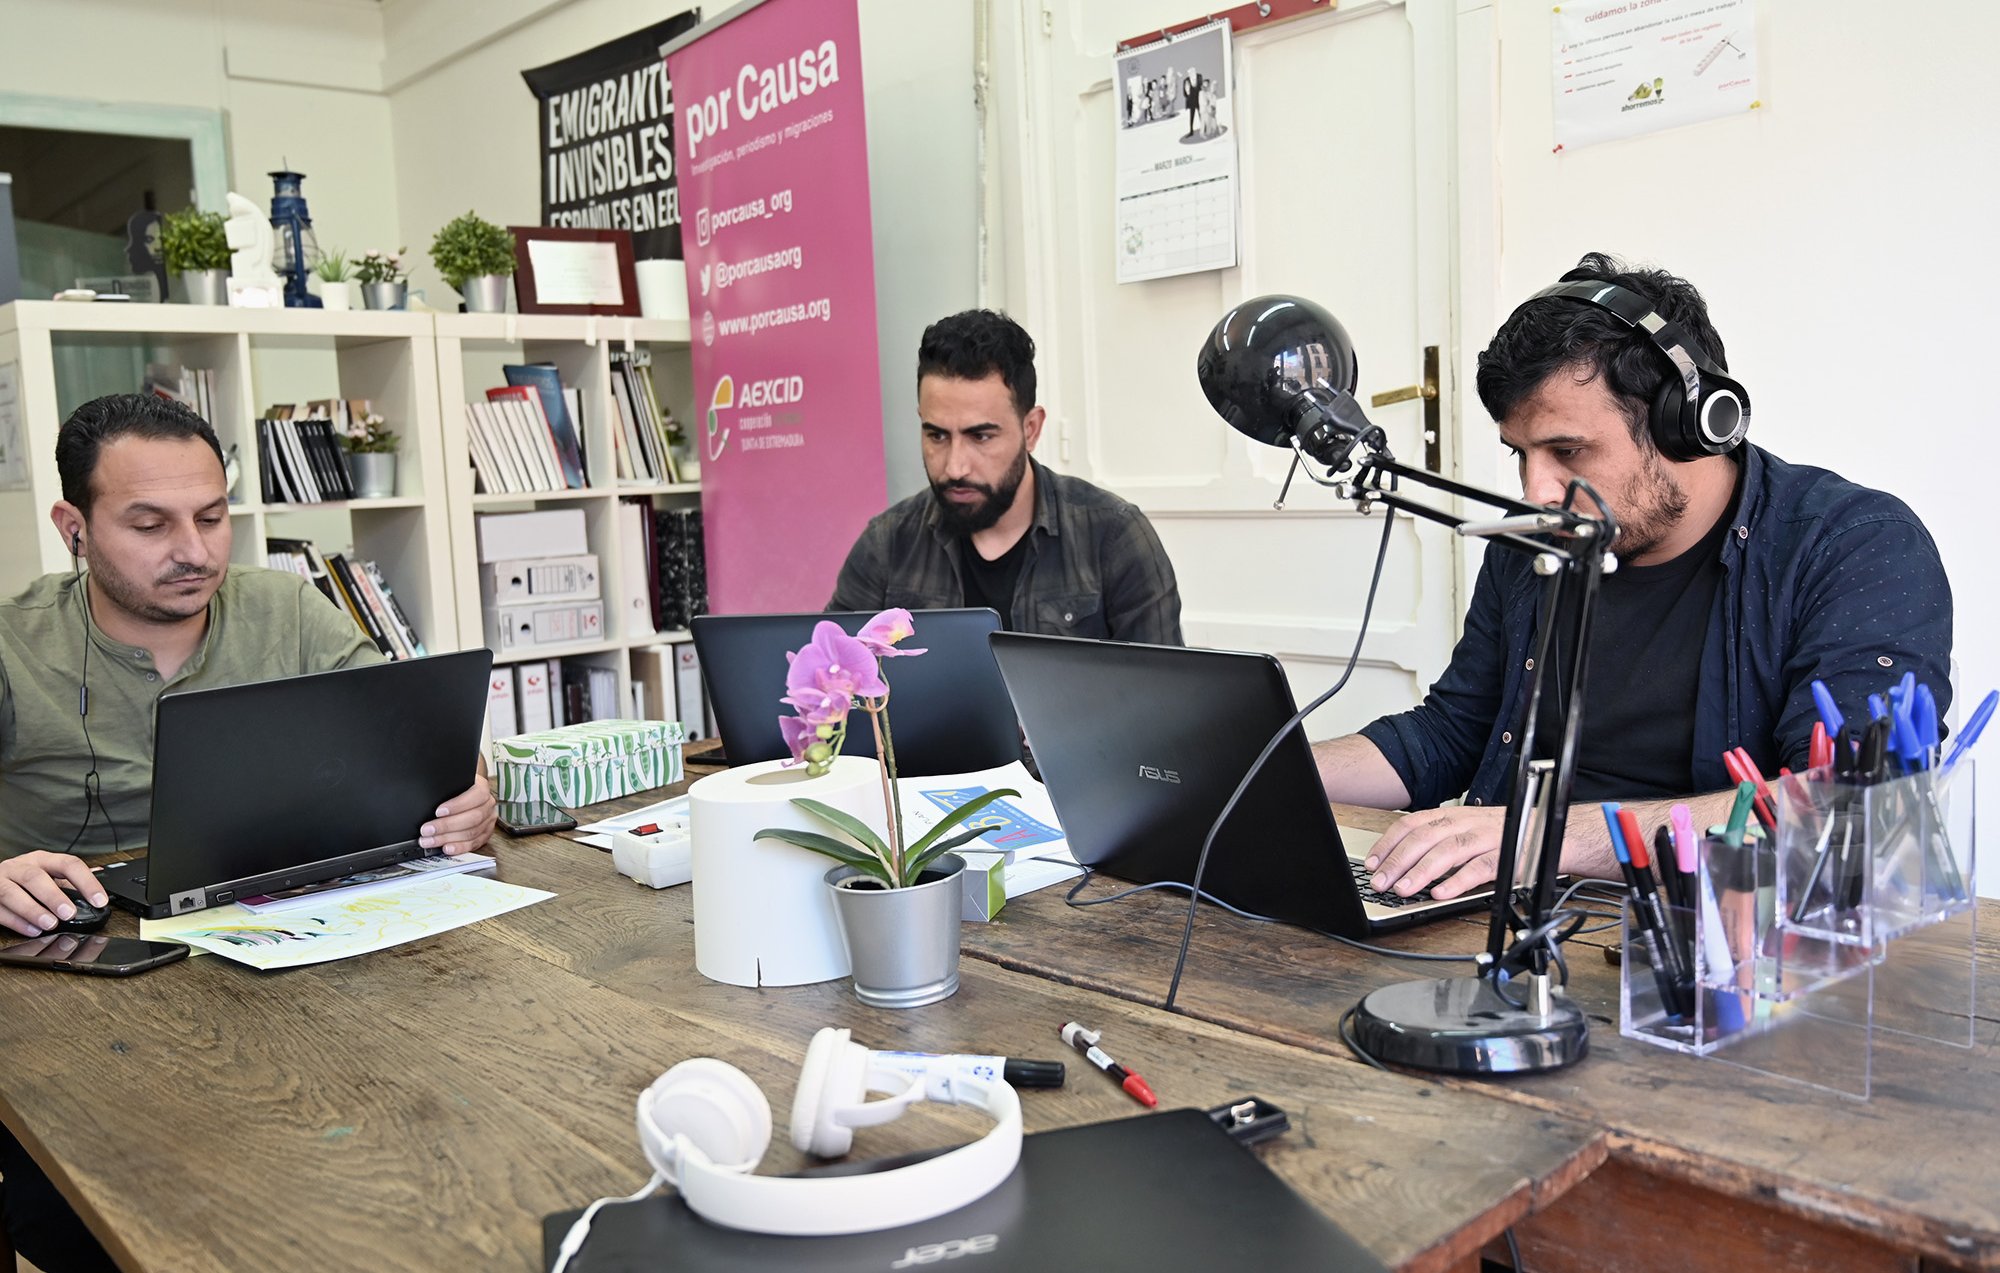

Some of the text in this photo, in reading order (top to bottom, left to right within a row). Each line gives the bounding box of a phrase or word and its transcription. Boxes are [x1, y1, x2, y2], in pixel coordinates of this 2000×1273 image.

[1584, 5, 1627, 23] cuidamos
[1629, 2, 1638, 11] la
[1602, 30, 1625, 41] persona
[550, 61, 675, 148] EMIGRANTE
[686, 39, 839, 159] por Causa
[1621, 98, 1657, 113] ahorremos
[736, 132, 777, 160] periodismo
[777, 130, 784, 144] y
[784, 109, 833, 139] migraciones
[549, 122, 673, 205] INVISIBLES
[633, 192, 655, 232] EN
[711, 189, 792, 234] porcausa_org
[715, 246, 802, 288] @porcausaorg
[718, 298, 831, 336] www.porcausa.org
[738, 375, 803, 409] AEXCID
[1139, 765, 1181, 784] ASUS
[890, 1233, 999, 1270] acer
